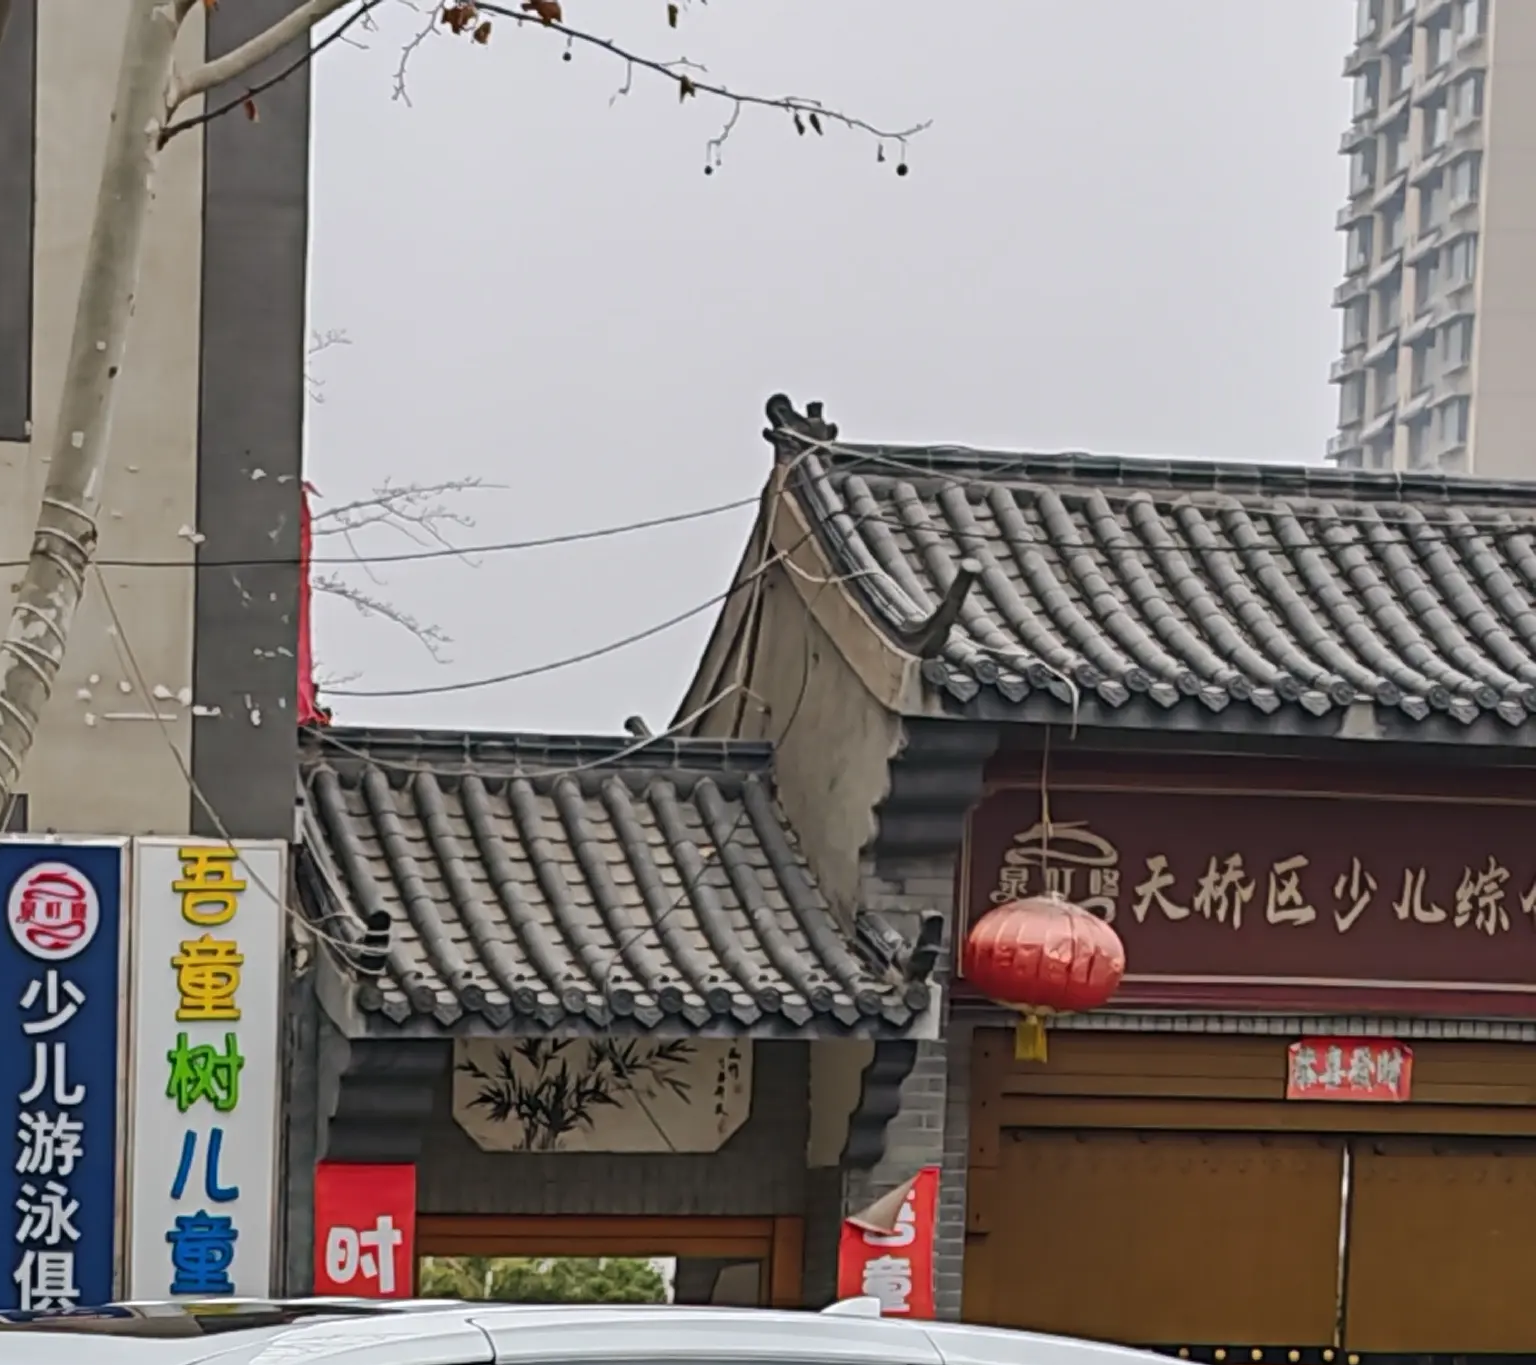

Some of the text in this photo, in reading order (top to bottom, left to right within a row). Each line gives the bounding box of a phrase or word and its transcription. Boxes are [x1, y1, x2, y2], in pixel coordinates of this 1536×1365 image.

[1133, 852, 1536, 936] 天桥区少儿综
[14, 970, 86, 1312] 少儿游泳俱
[166, 847, 247, 1295] 吾童树儿童
[326, 1216, 402, 1293] 时
